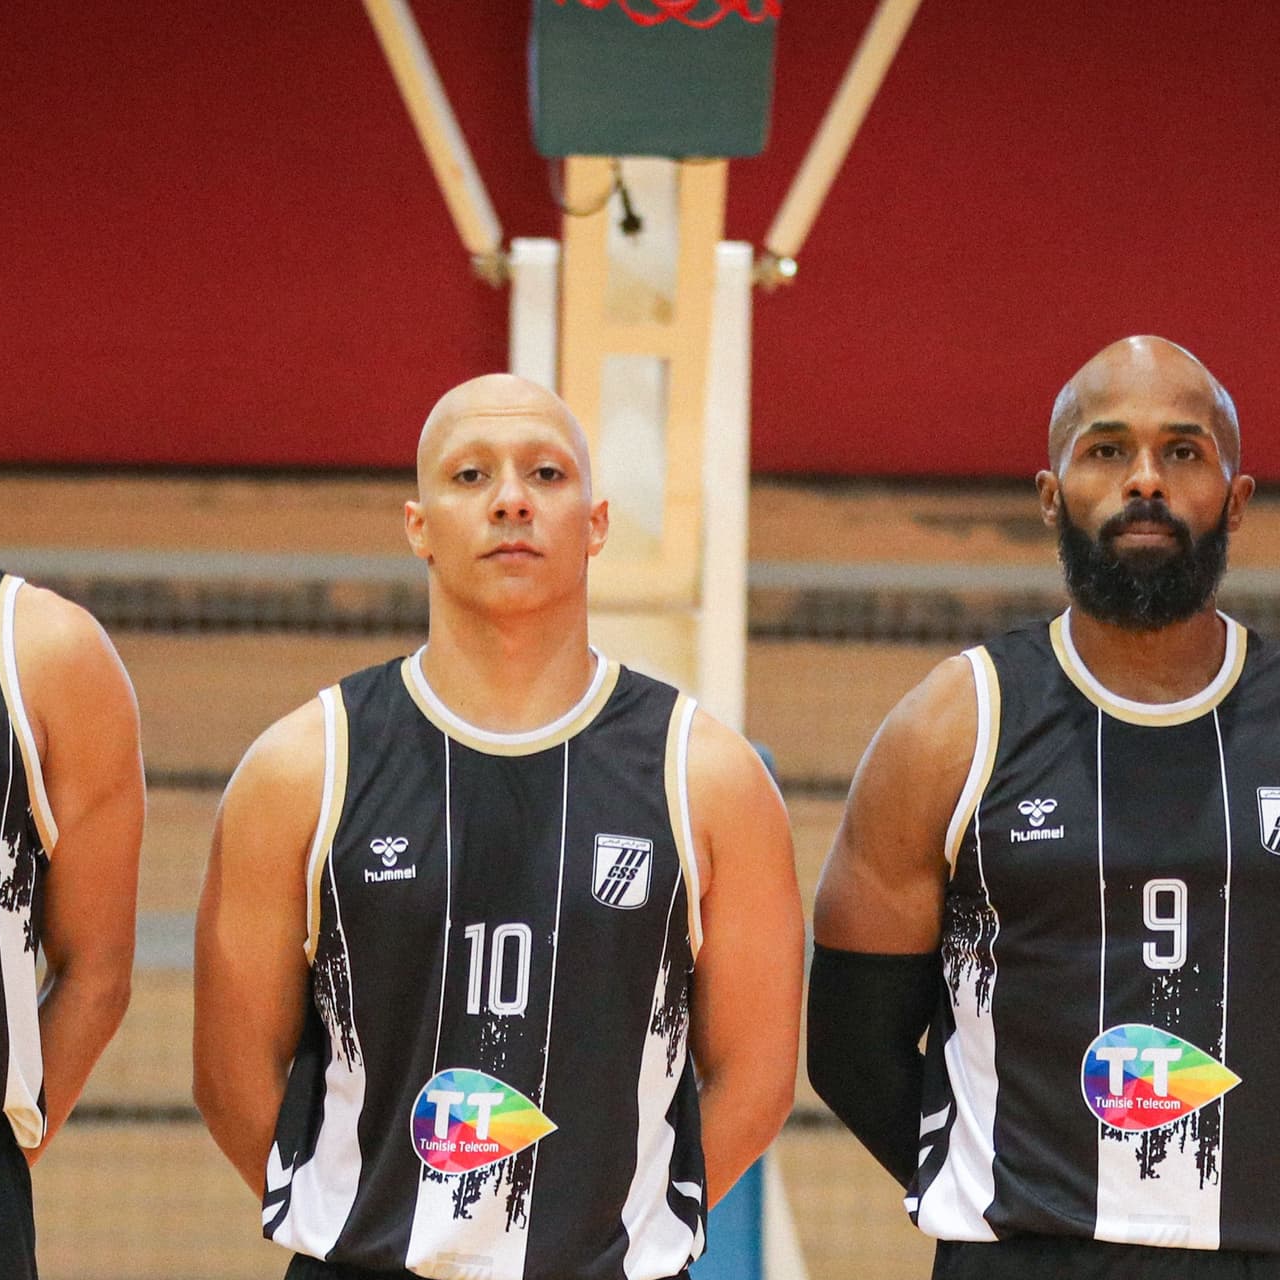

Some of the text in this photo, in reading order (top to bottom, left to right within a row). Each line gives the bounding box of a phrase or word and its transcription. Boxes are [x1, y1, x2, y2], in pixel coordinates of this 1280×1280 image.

[1010, 824, 1065, 843] hummel
[364, 863, 417, 883] hummel
[607, 865, 639, 881] CSS
[1142, 878, 1188, 971] 9
[464, 922, 533, 1016] 10
[1095, 1047, 1183, 1097] TT
[1095, 1096, 1181, 1110] Tunisie Telecom
[426, 1090, 505, 1140] TT
[420, 1138, 499, 1153] Tunisie Telecom
